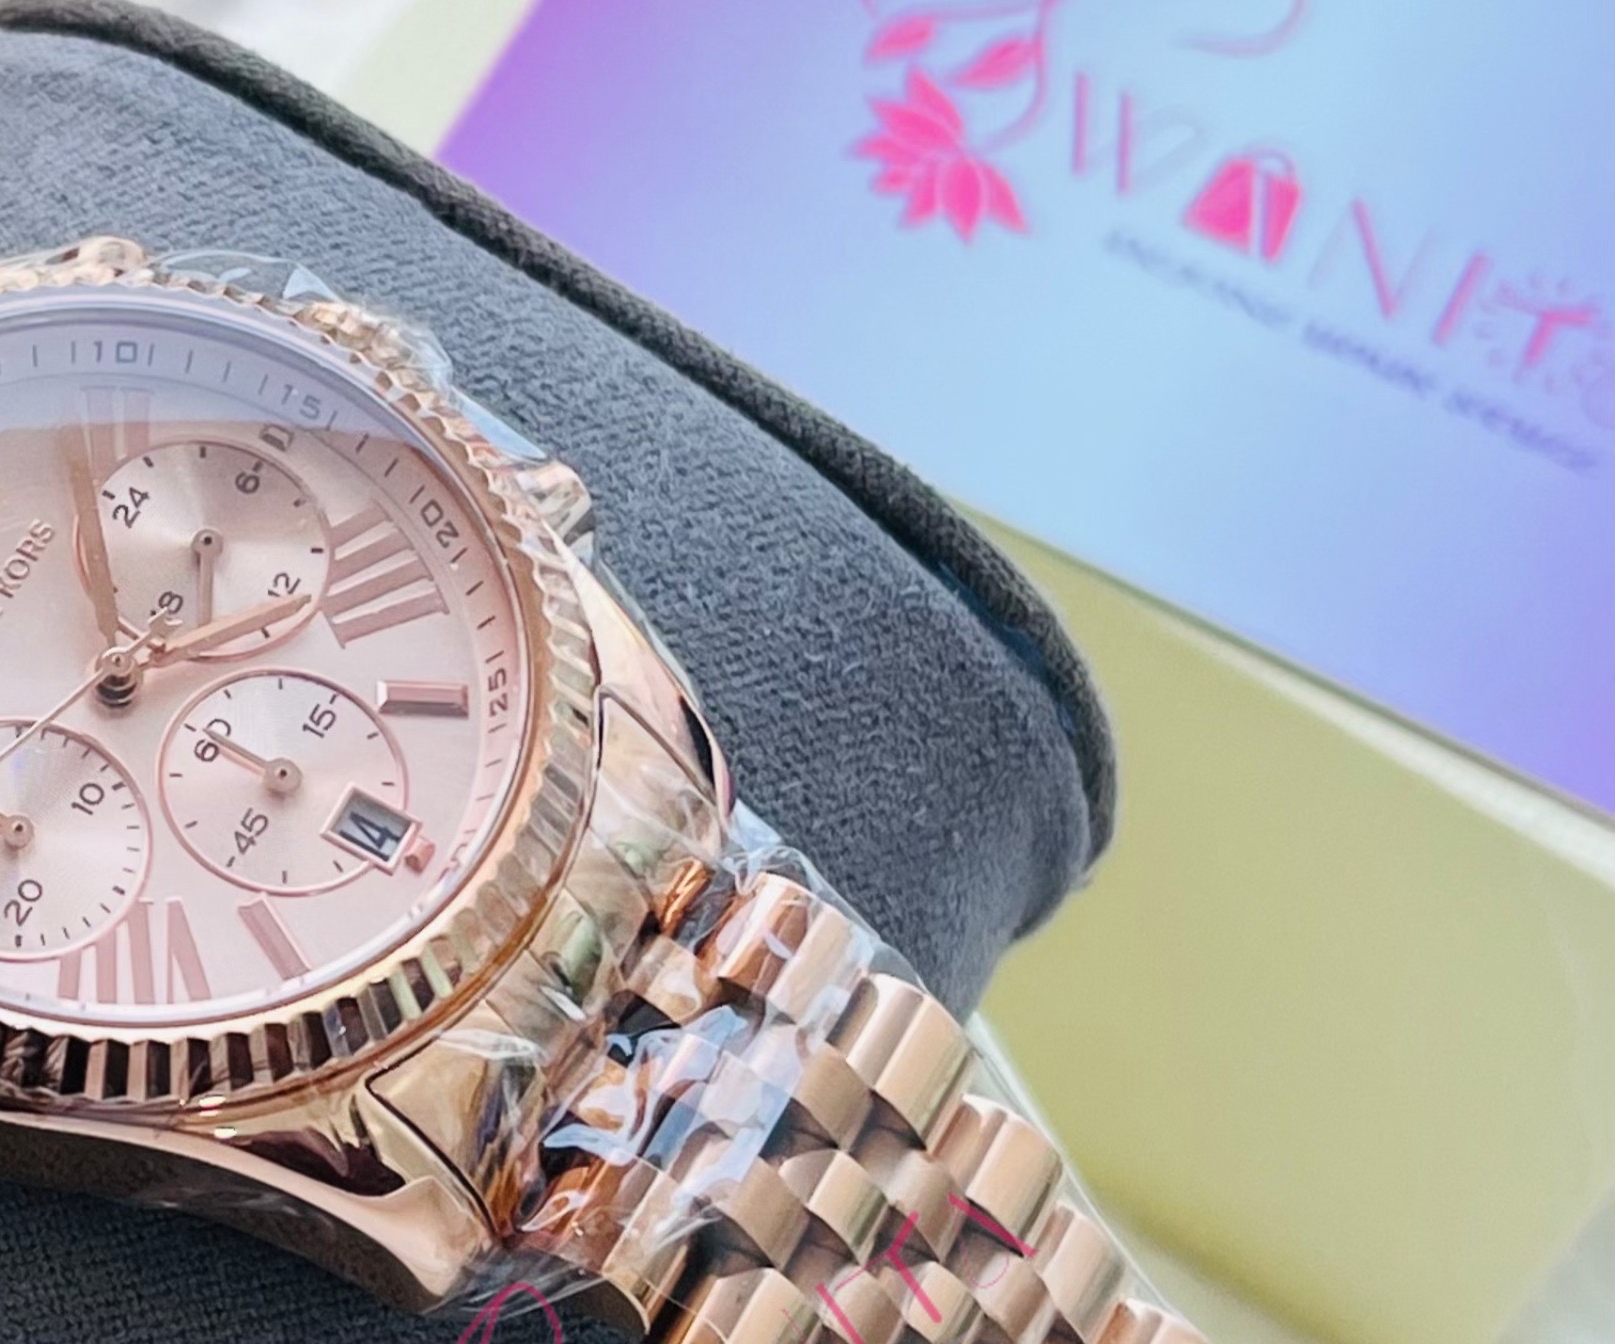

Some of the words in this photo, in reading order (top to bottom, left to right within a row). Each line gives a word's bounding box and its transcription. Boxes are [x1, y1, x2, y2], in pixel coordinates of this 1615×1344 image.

[1073, 68, 1603, 370] WANIT
[91, 339, 140, 365] 10
[284, 383, 323, 421] 15
[234, 468, 261, 495] 6
[111, 485, 151, 528] 24
[419, 498, 460, 549] 20
[267, 571, 302, 600] 12
[487, 666, 509, 715] 25
[193, 717, 233, 764] 60
[300, 702, 338, 739] 15
[70, 781, 106, 817] 10
[232, 807, 270, 855] 45
[3, 877, 44, 927] 20
